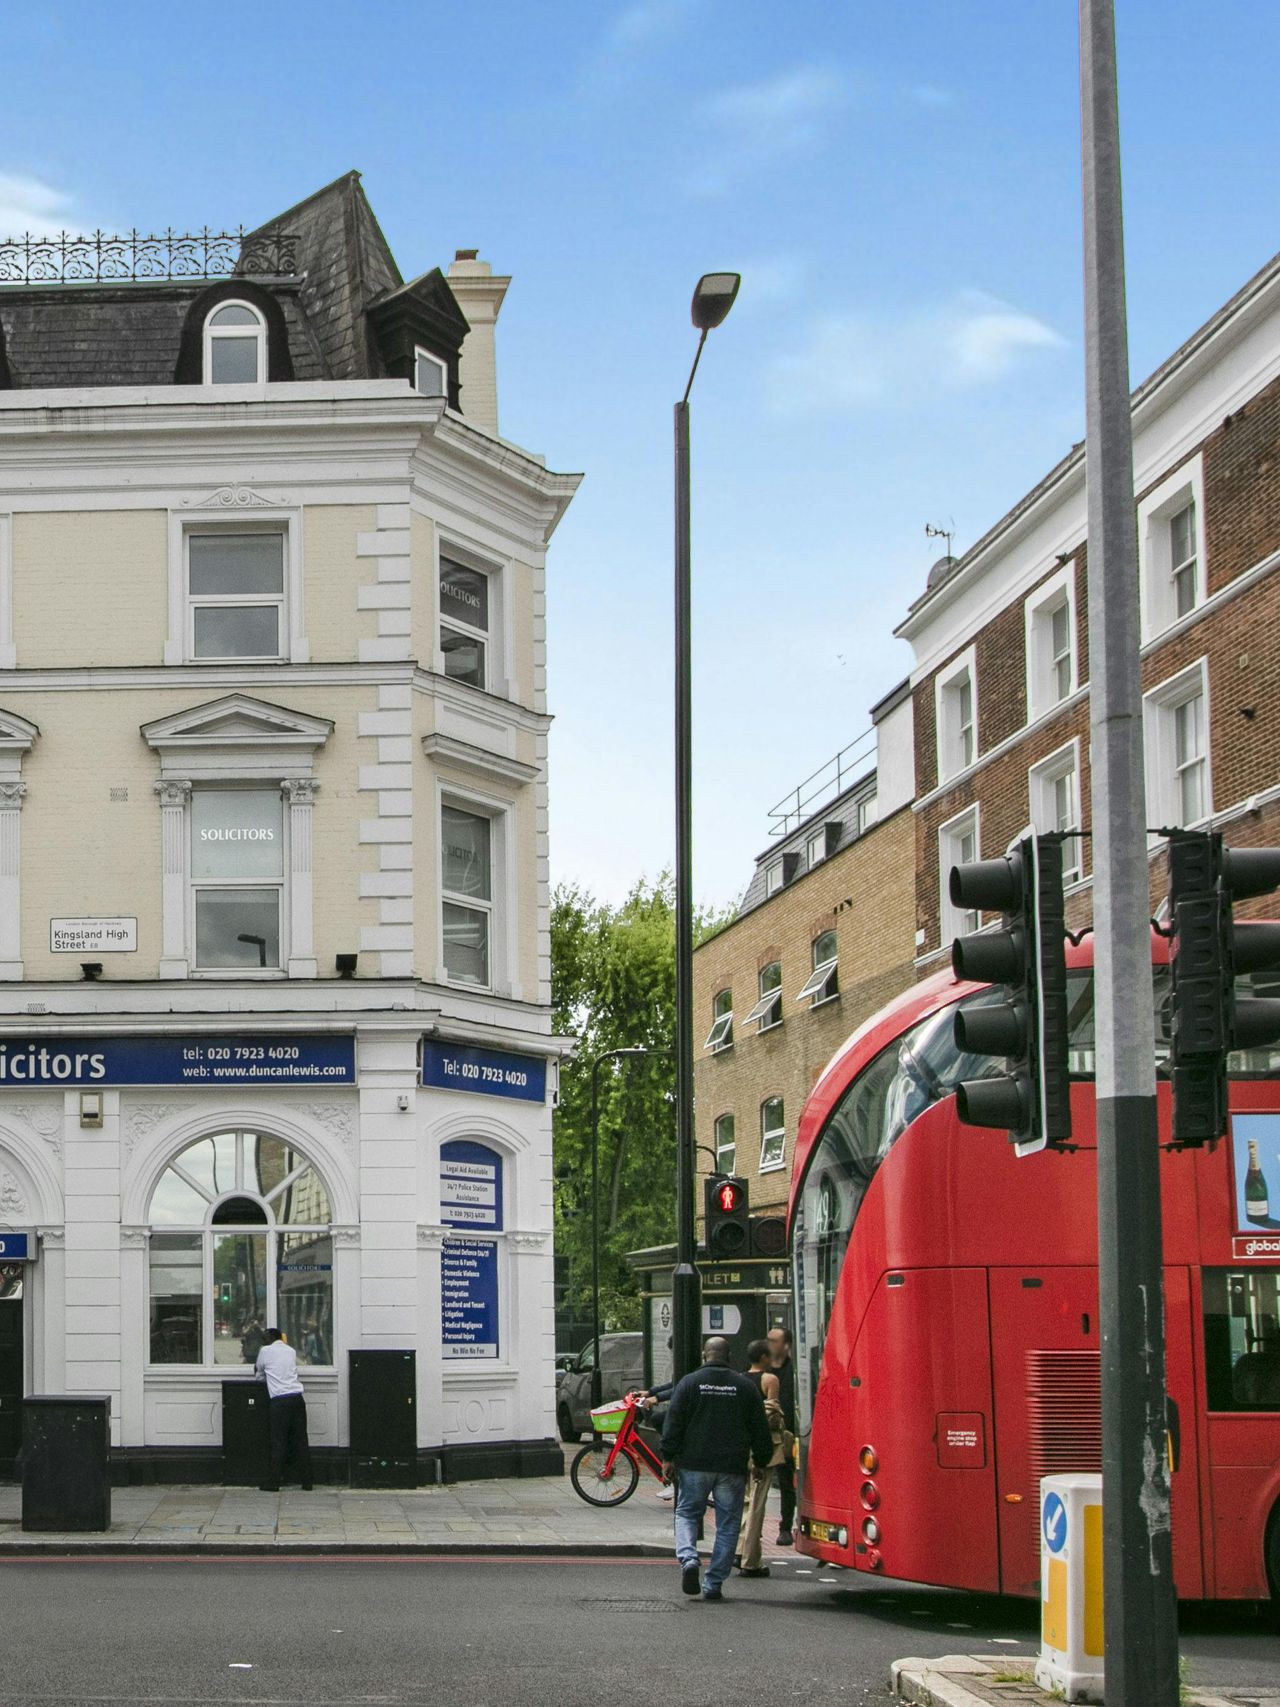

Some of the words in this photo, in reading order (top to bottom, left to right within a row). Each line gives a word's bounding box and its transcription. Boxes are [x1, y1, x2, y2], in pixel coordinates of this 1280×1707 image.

[440, 581, 480, 608] OLICITORS
[200, 828, 274, 841] SOLICITORS
[54, 930, 102, 940] Kingsland
[106, 929, 129, 940] High
[55, 940, 86, 949] Street
[183, 1047, 204, 1060] tel:
[207, 1048, 230, 1060] 020
[234, 1047, 265, 1060] 7923
[268, 1047, 300, 1059] 4020
[183, 1065, 211, 1077] web:
[213, 1064, 347, 1077] www.duncanlewis.com
[442, 1058, 460, 1076] Tel:
[462, 1063, 479, 1079] 020
[481, 1066, 503, 1083] 7923
[505, 1070, 527, 1087] 4020
[703, 1273, 729, 1285] ILET
